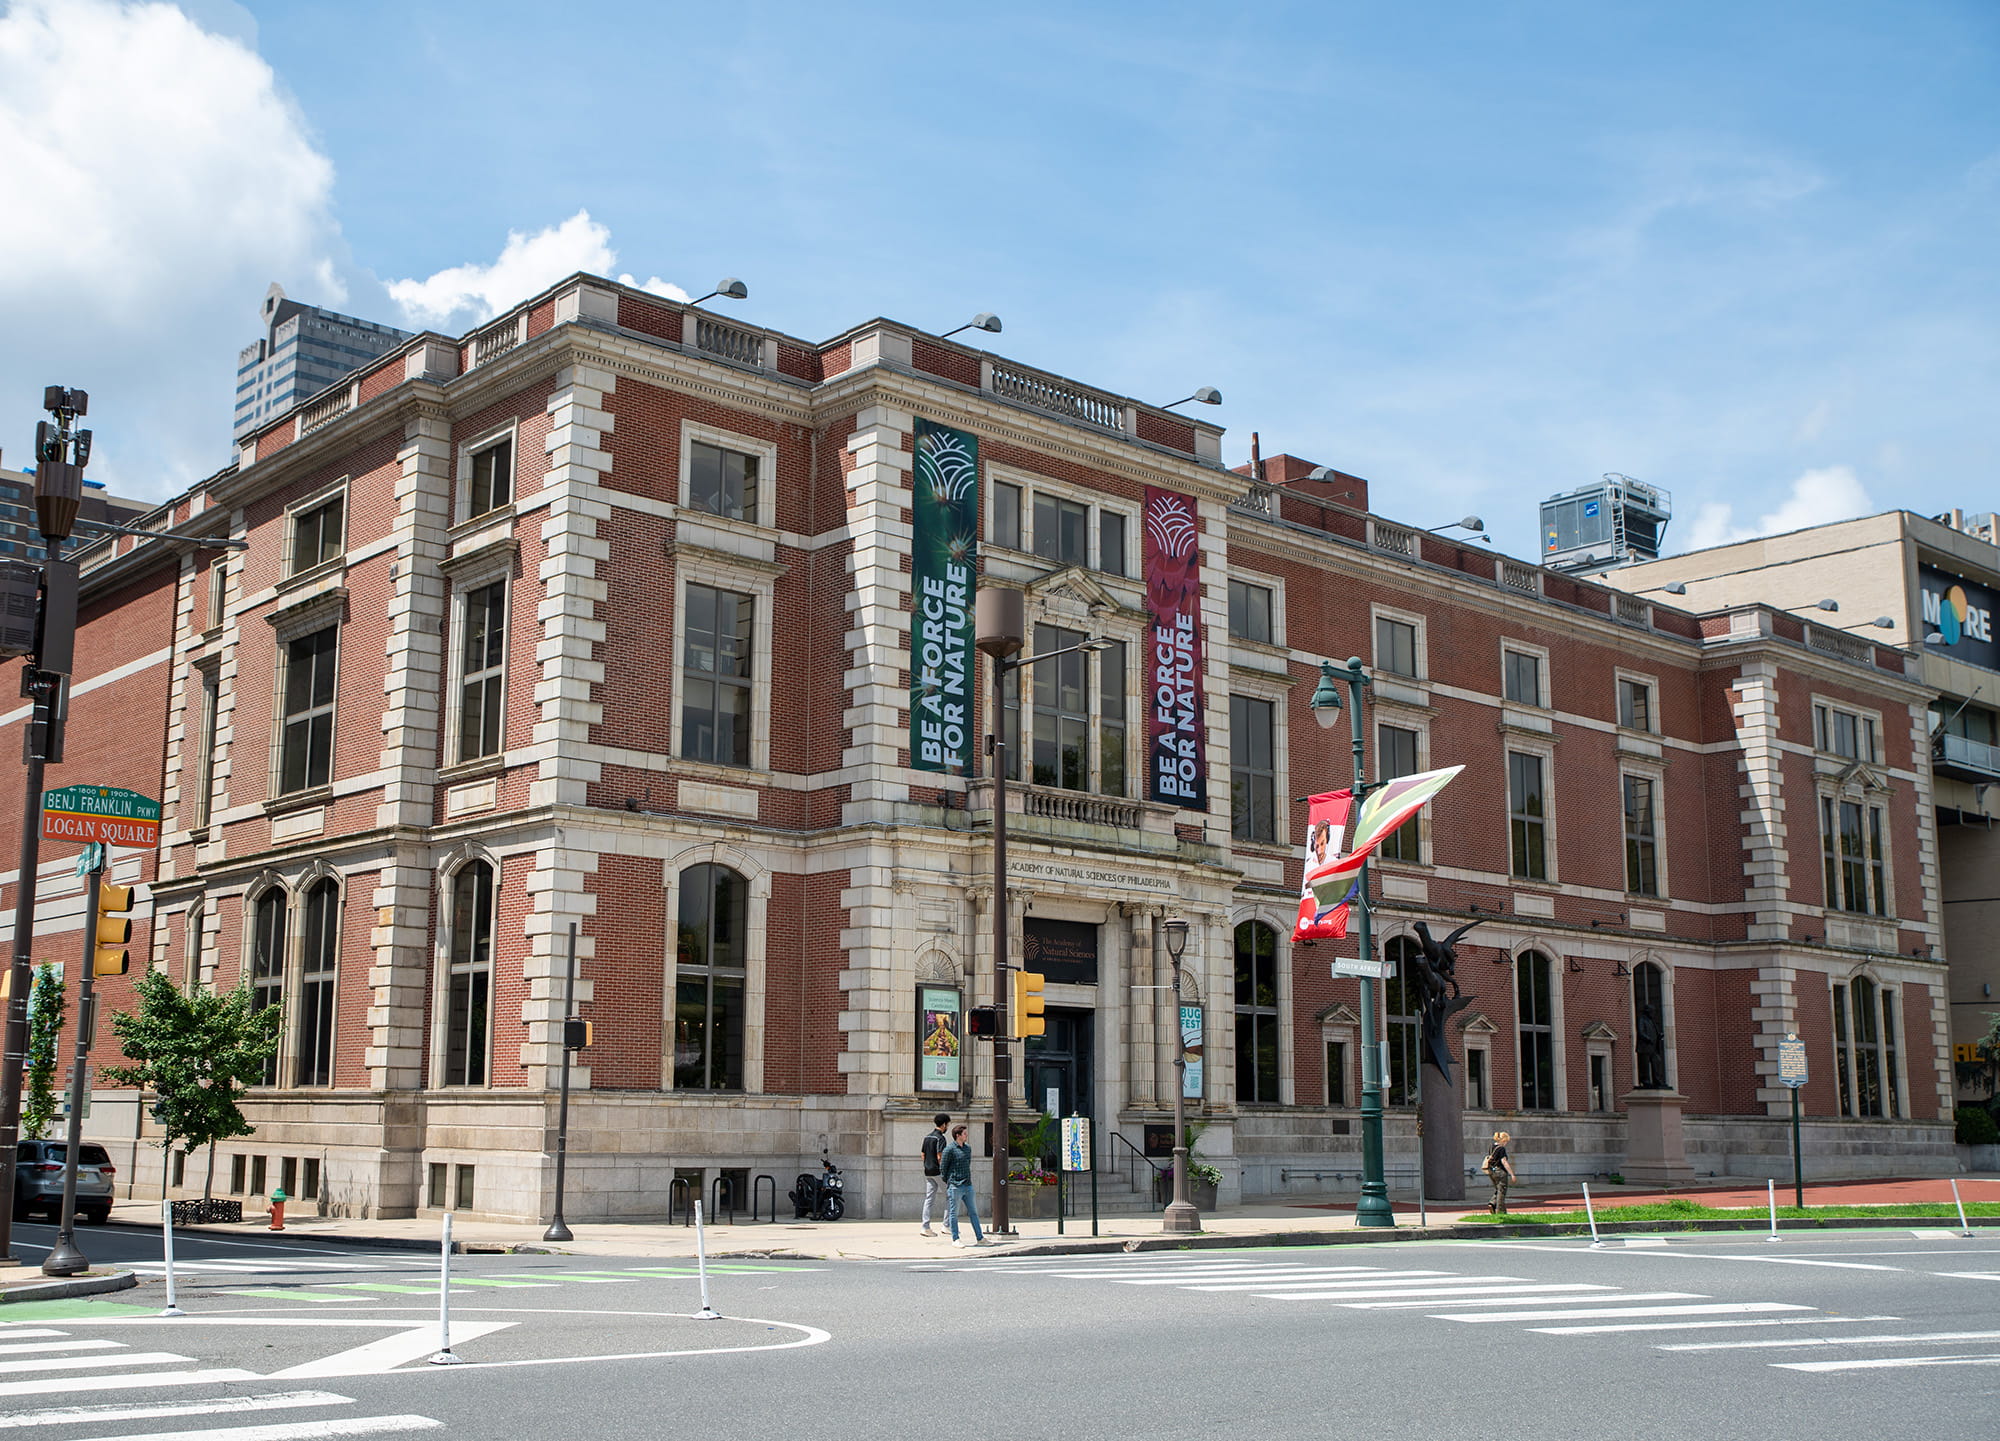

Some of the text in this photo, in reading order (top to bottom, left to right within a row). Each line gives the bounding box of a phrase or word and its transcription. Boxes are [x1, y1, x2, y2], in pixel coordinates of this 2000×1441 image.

[921, 576, 944, 764] BE A FORCE
[943, 563, 967, 767] FOR NATURE
[1157, 625, 1177, 796] BE A FORCE
[1175, 612, 1197, 798] FOR NATURE
[47, 792, 157, 818] BENJ FRANKLIN PKWY
[78, 787, 129, 798] 1800 W 1900
[45, 817, 155, 843] LOGAN SQUARE
[1011, 862, 1044, 874] ACADEMY
[1045, 865, 1055, 875] OF
[1055, 867, 1085, 879] NATURAL
[1085, 870, 1117, 882] SCIENCES
[1117, 874, 1126, 884] OF
[1127, 875, 1171, 889] PHILADELPHIA
[1337, 962, 1381, 973] SOUTH AFRICA
[1180, 1007, 1201, 1019] BUG
[1180, 1019, 1201, 1029] FEST
